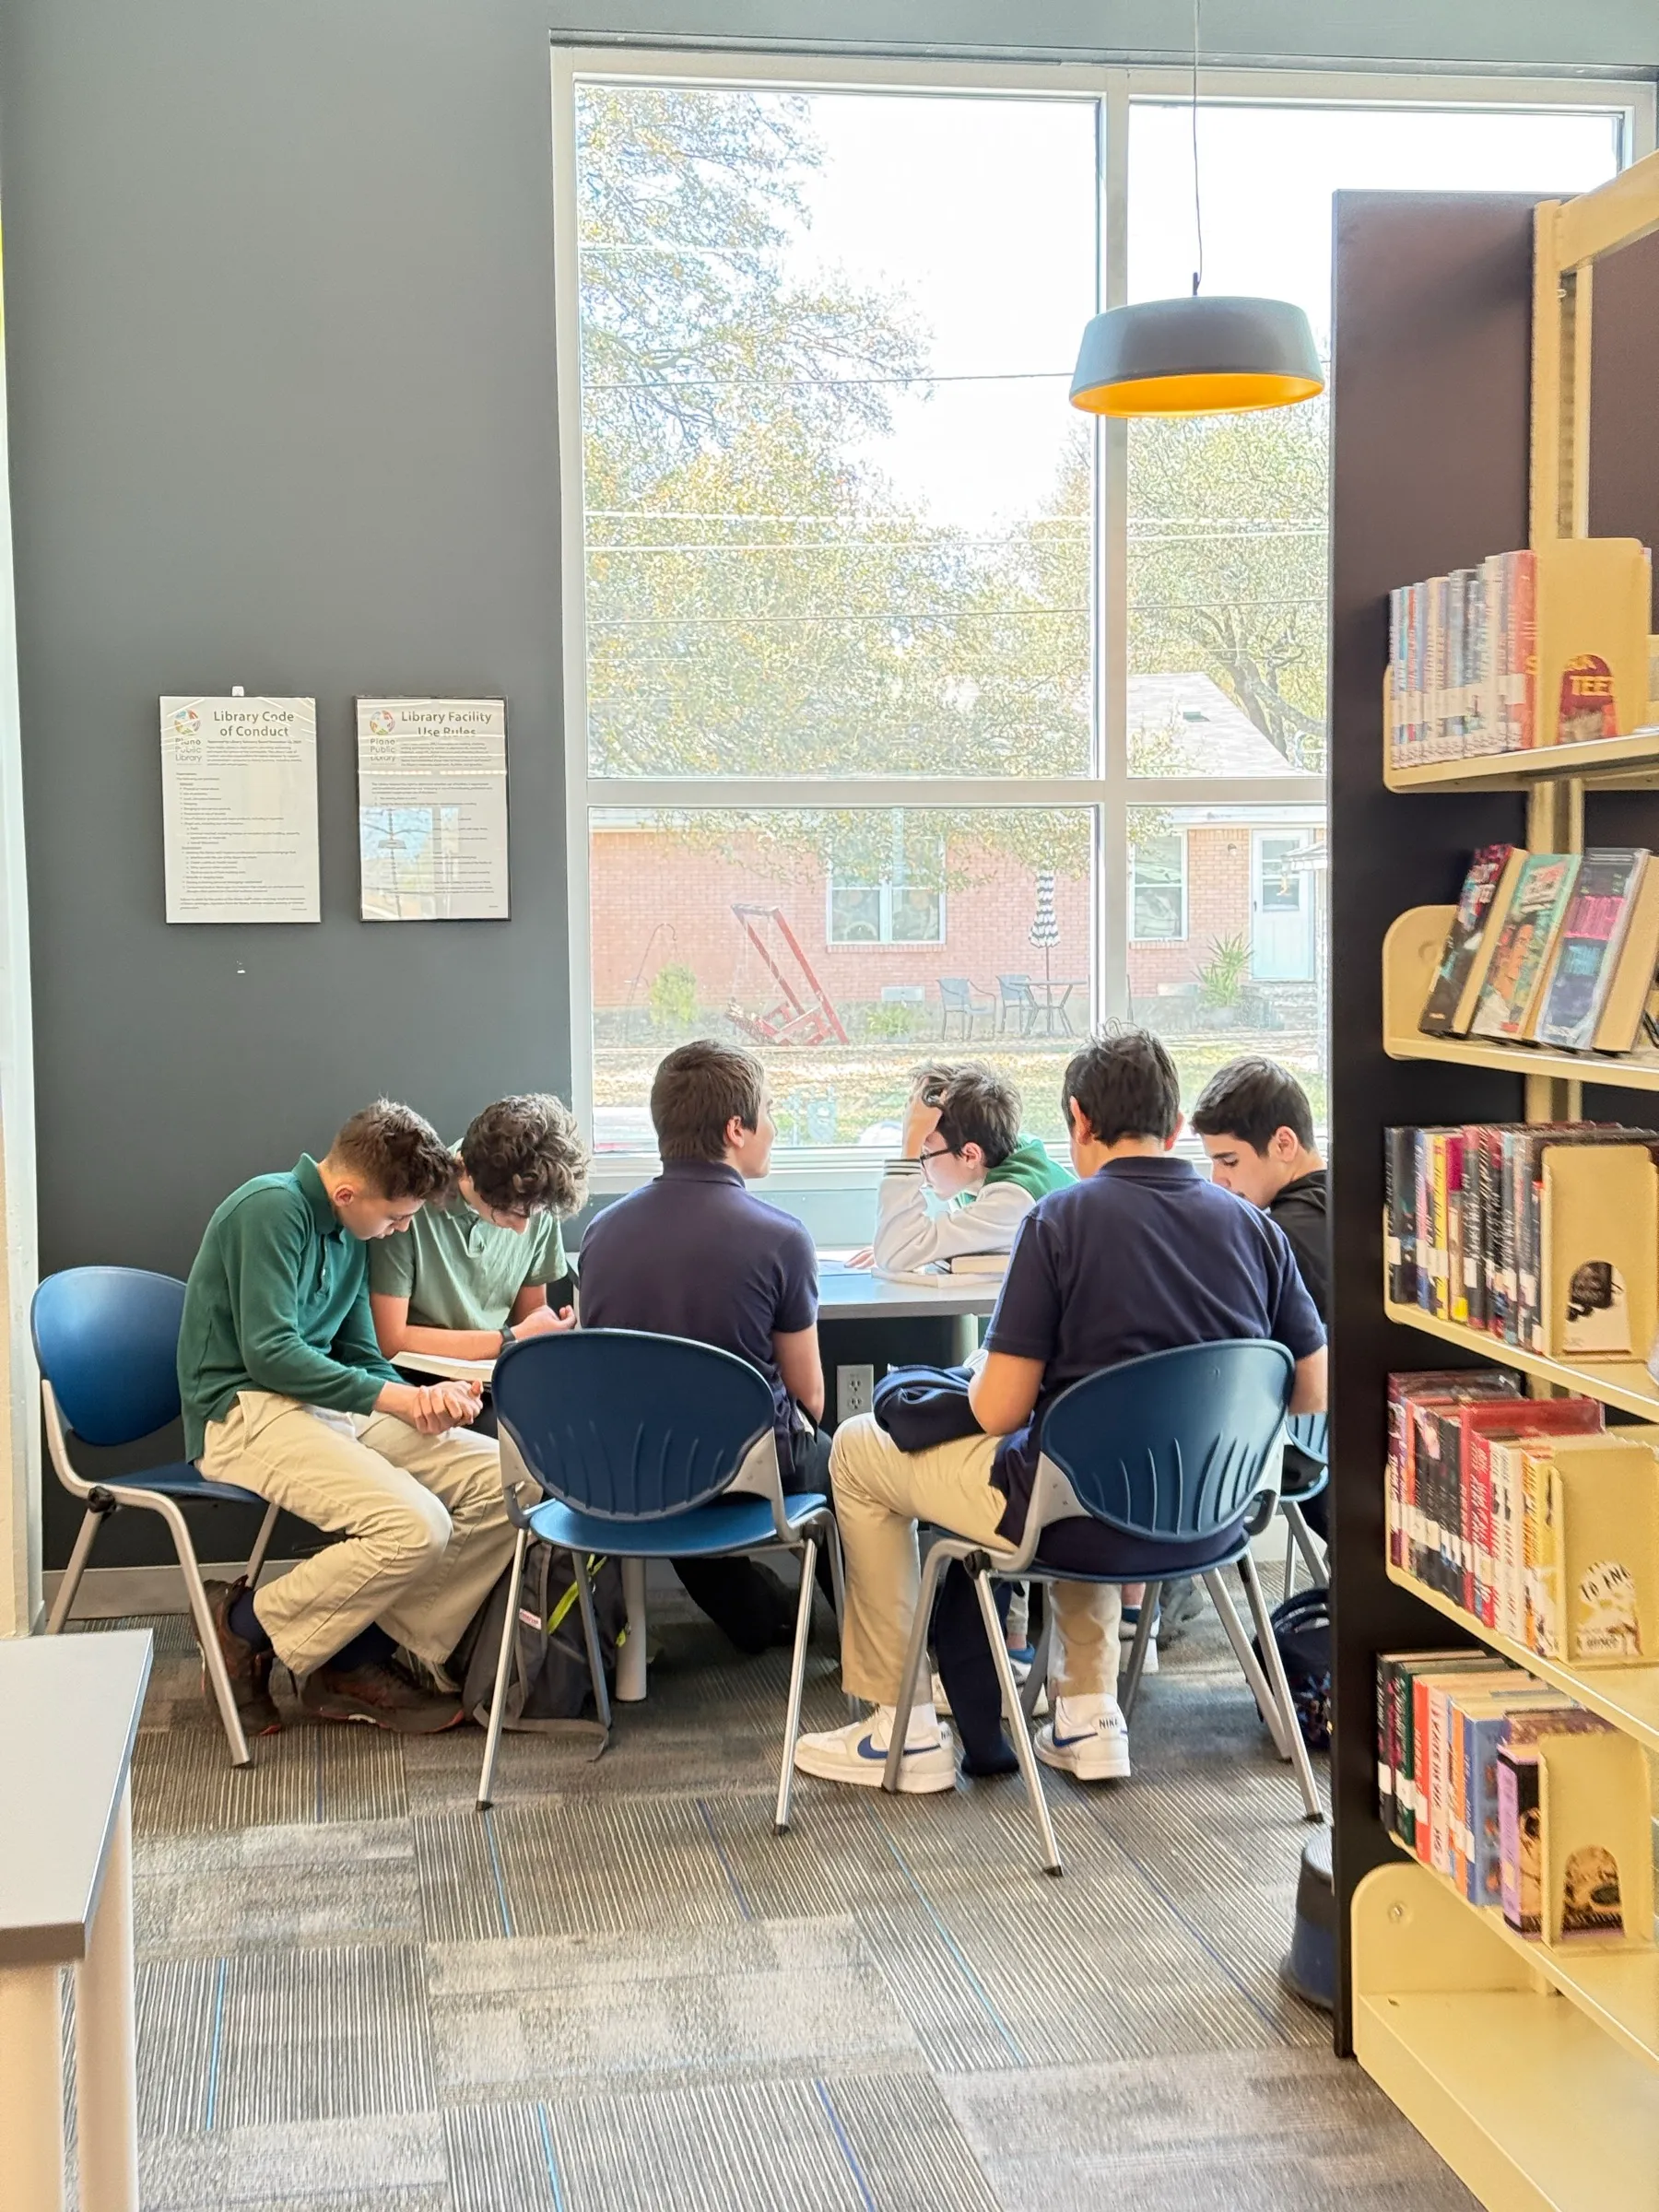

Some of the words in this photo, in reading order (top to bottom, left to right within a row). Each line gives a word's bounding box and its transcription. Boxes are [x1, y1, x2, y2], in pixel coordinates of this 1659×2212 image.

[214, 711, 259, 724] Library
[262, 712, 294, 723] Code
[401, 711, 445, 724] Library
[449, 712, 492, 724] Facility
[220, 726, 233, 736] of
[236, 726, 288, 736] Conduct
[418, 726, 441, 737] Use
[443, 726, 477, 737] Rules
[370, 746, 396, 754] Public
[175, 754, 202, 762] Library
